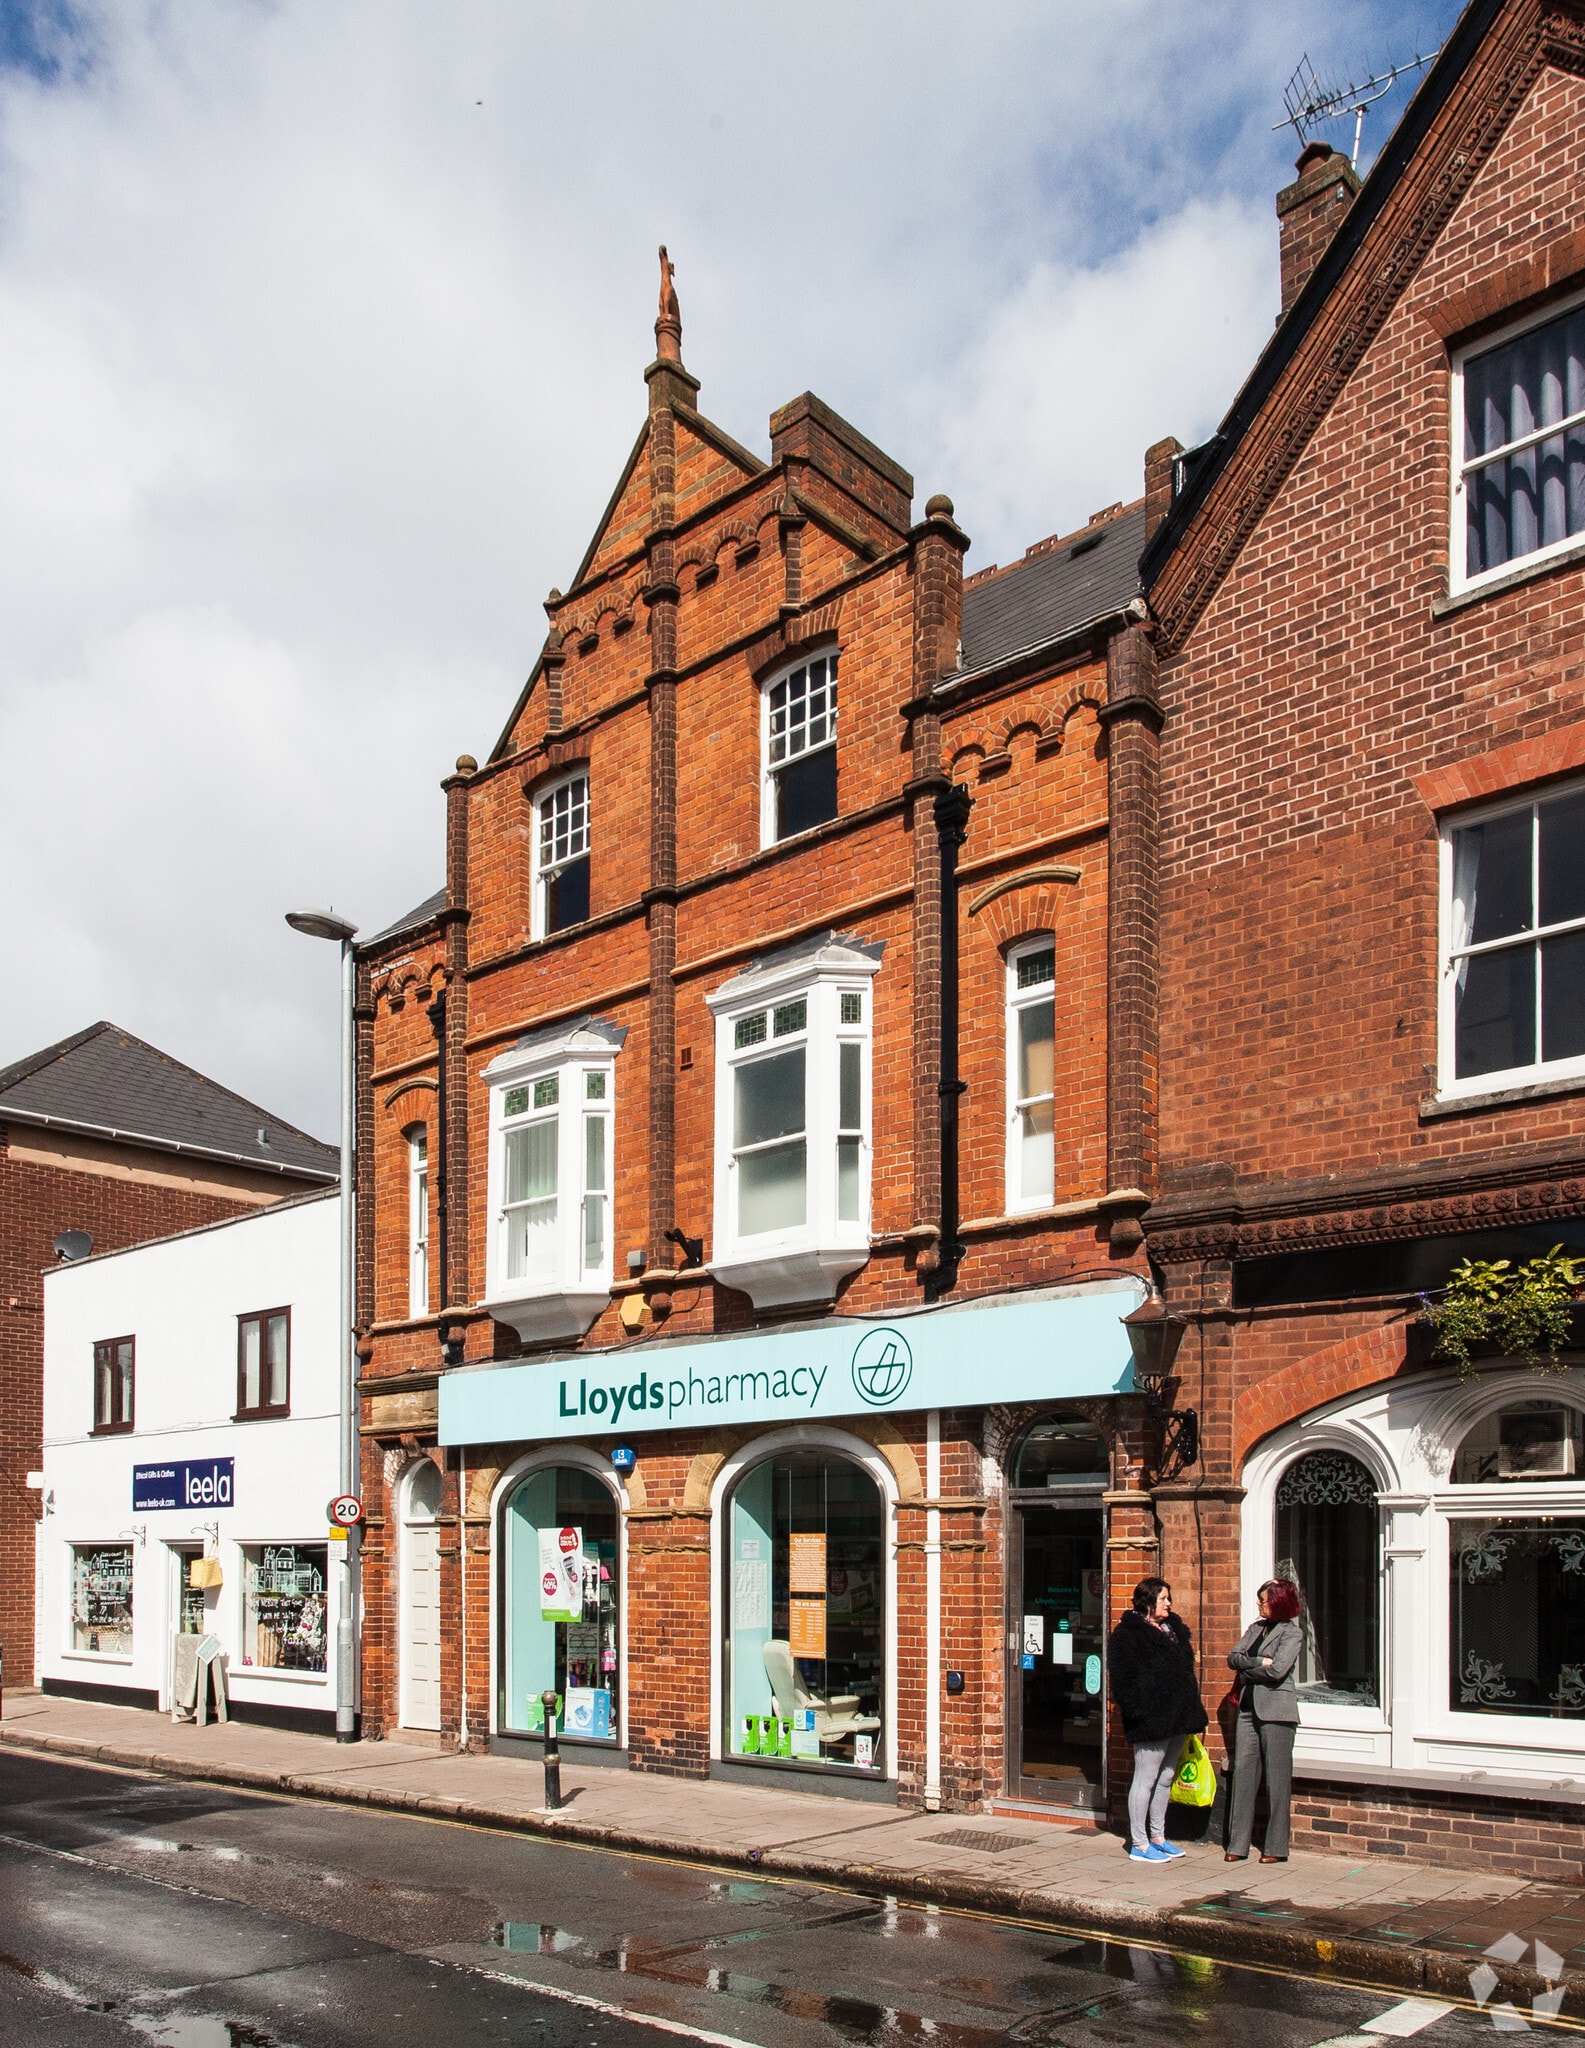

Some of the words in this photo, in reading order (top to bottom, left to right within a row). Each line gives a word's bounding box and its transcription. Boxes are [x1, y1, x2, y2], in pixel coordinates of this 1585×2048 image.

[559, 1365, 828, 1424] Lloydspharmacy
[136, 1472, 147, 1480] Ethical
[148, 1471, 156, 1479] Gifts
[161, 1470, 175, 1478] Clothes
[185, 1465, 230, 1504] leela
[135, 1498, 175, 1508] www.leela-uk.com
[337, 1504, 358, 1516] 20
